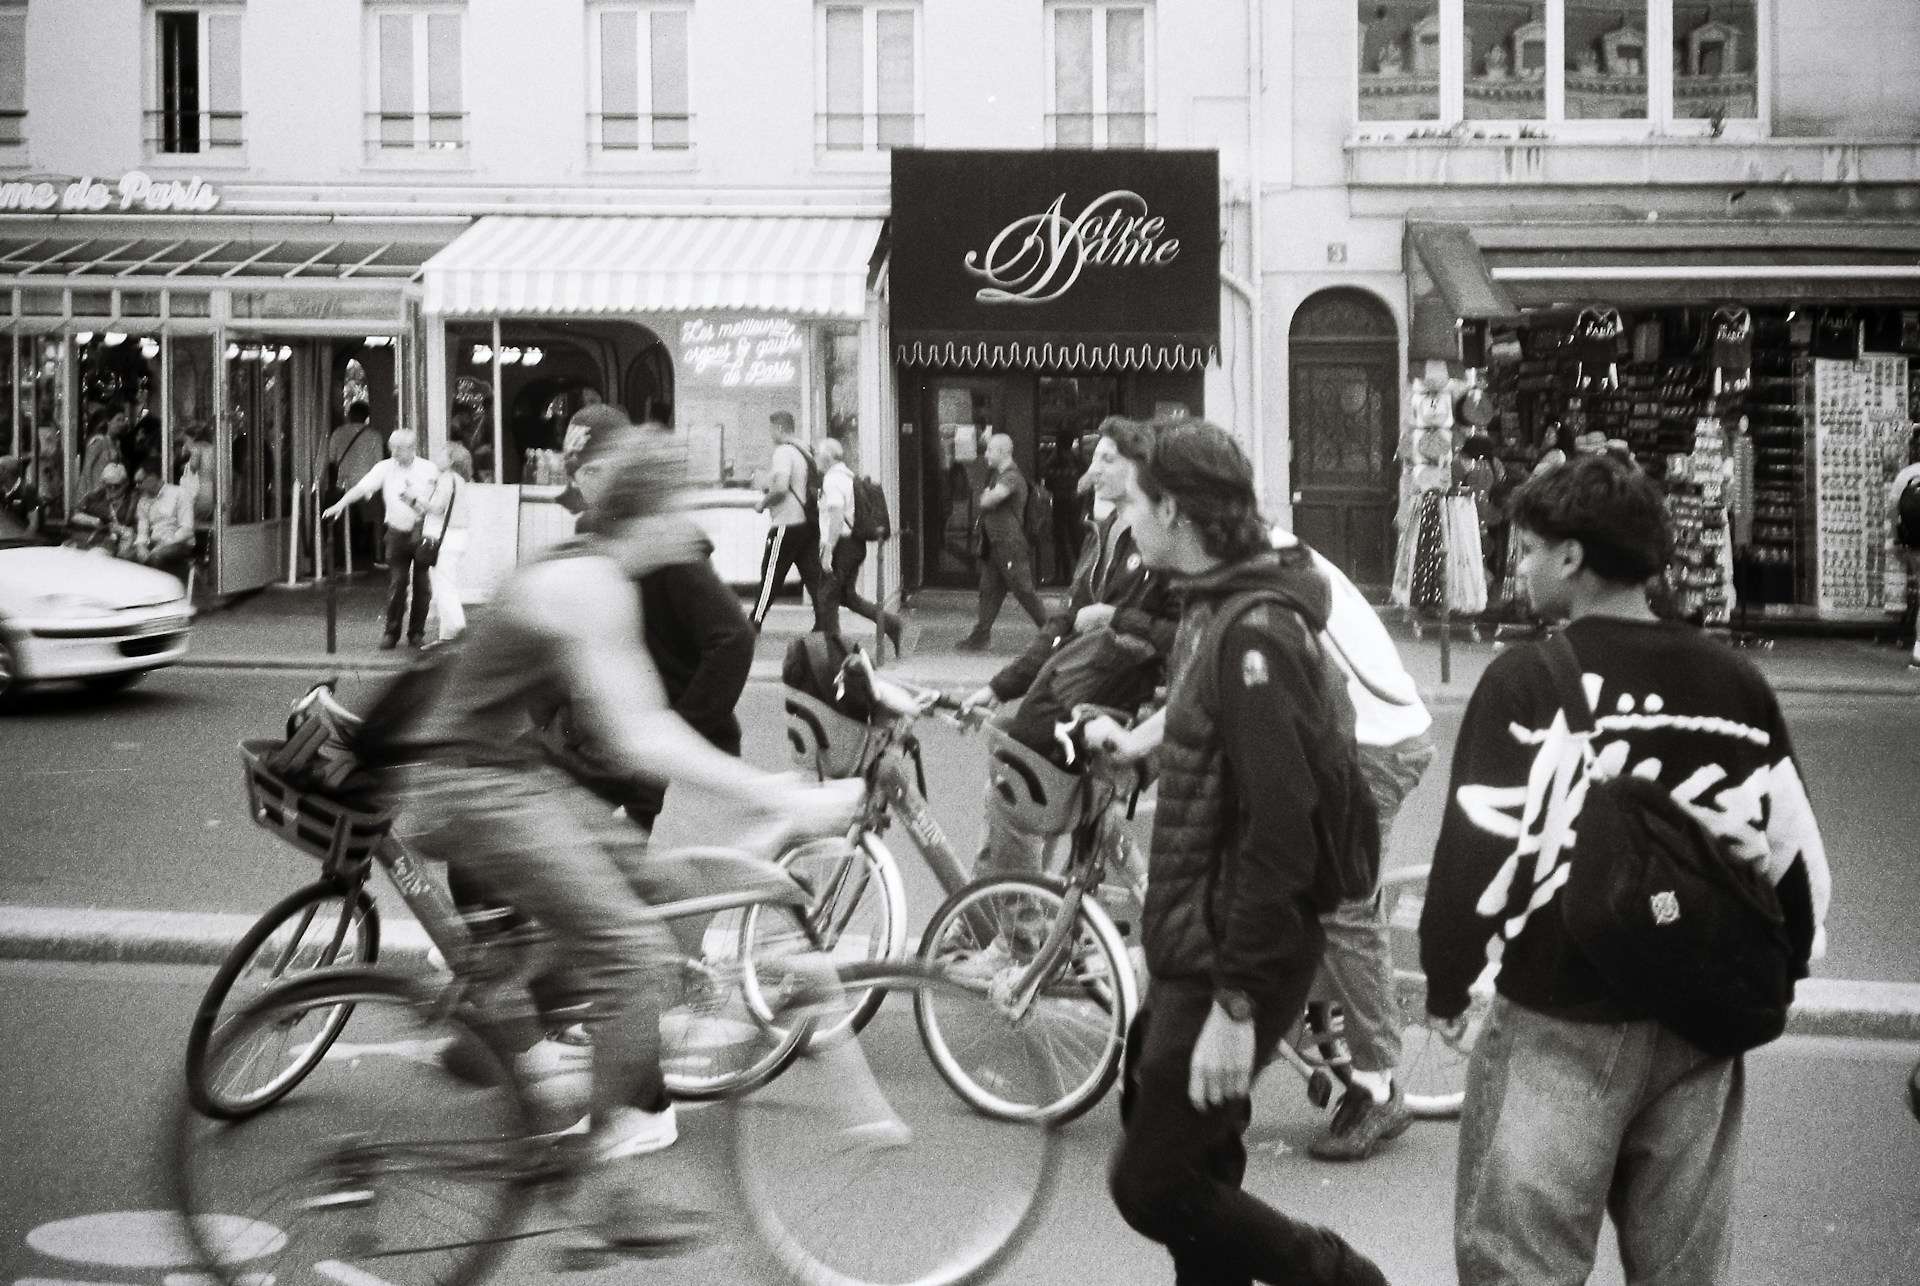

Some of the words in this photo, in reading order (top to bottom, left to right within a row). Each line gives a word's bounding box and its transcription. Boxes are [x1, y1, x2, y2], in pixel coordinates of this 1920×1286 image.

[62, 176, 112, 210] de
[118, 170, 220, 212] Paris
[682, 318, 715, 343] Les
[721, 362, 741, 386] de
[744, 360, 795, 384] Paris
